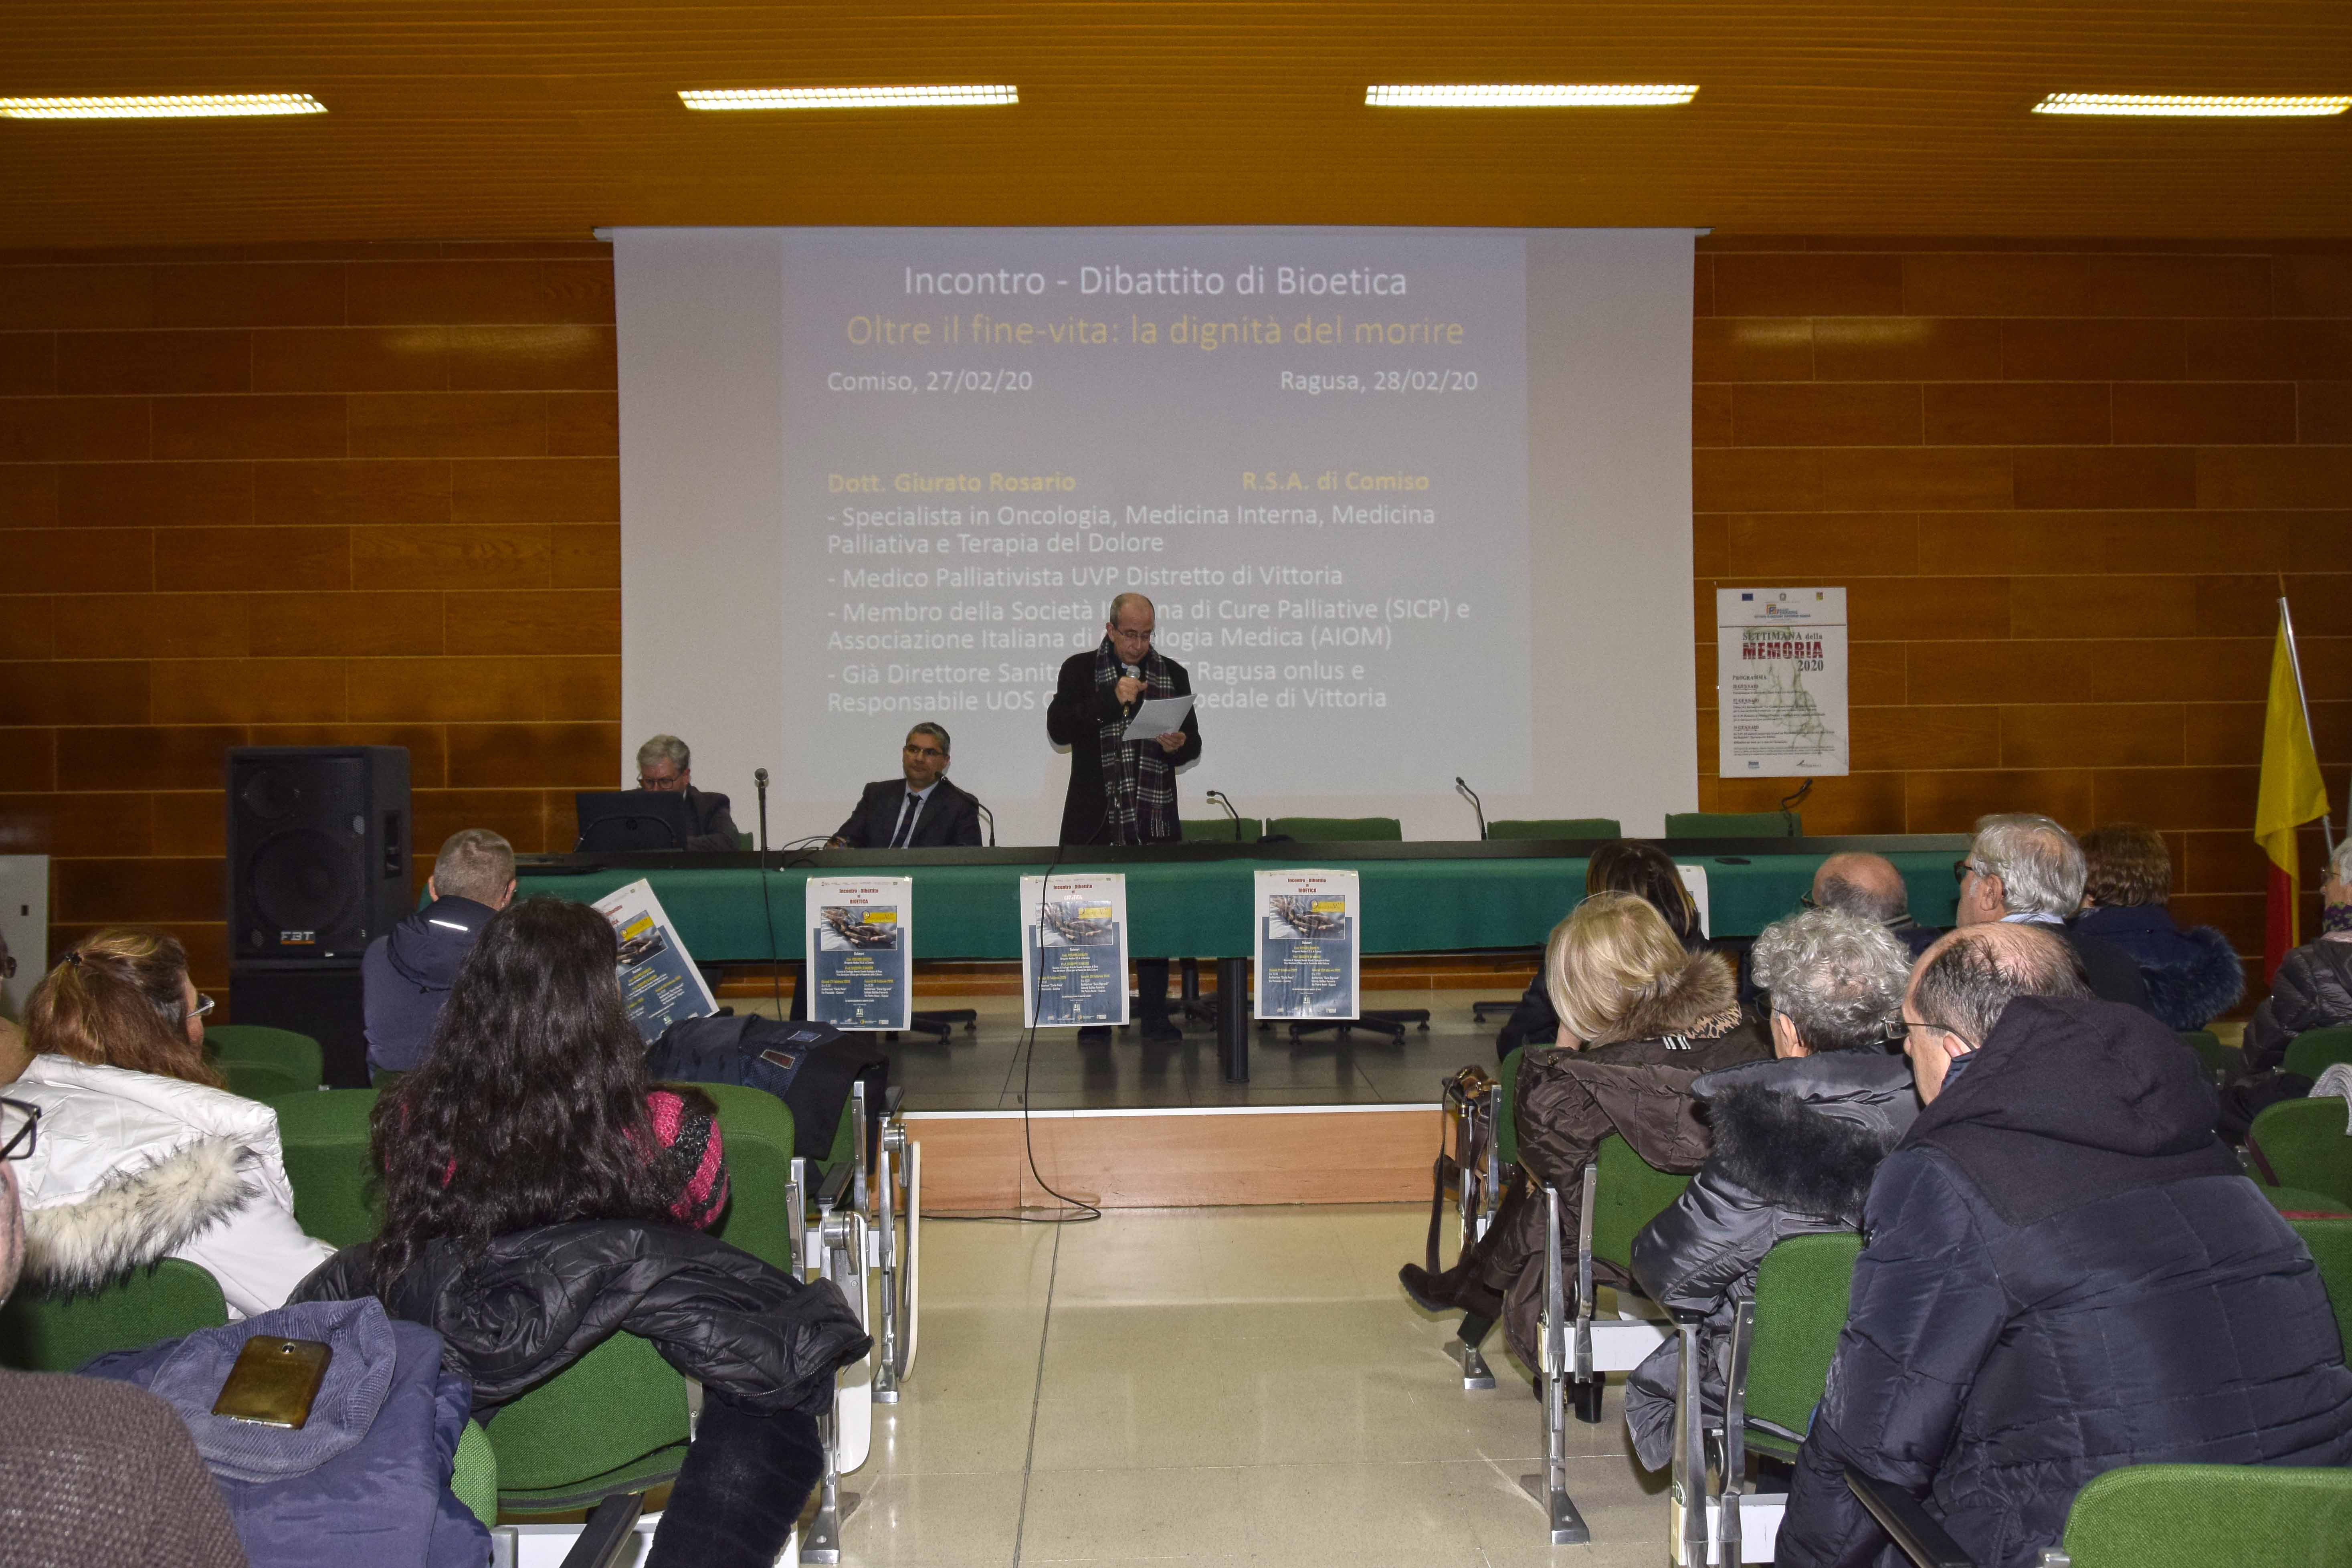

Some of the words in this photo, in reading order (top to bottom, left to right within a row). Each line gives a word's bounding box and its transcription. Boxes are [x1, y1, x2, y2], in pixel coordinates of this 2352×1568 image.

[906, 267, 1045, 295] Incontro
[1080, 265, 1224, 295] Dibattito
[1236, 265, 1265, 295] di
[1277, 266, 1407, 296] Bioetica
[848, 315, 931, 345] Oltre
[942, 315, 961, 344] il
[972, 314, 1119, 345] fine-vita:
[1131, 314, 1158, 344] la
[1170, 314, 1282, 351] dignità
[1294, 315, 1344, 344] del
[1355, 317, 1464, 345] morire
[828, 372, 918, 394] Comiso,
[927, 369, 1033, 394] 27/02/20
[1281, 371, 1366, 395] Ragusa,
[1374, 369, 1479, 394] 28/02/20
[828, 474, 886, 493] Dott.
[895, 473, 982, 493] Giurato
[989, 472, 1076, 493] Rosario
[1243, 471, 1309, 490] R.S.A.
[1318, 471, 1337, 490] di
[1346, 471, 1430, 491] Comiso
[843, 505, 962, 530] Specialista
[970, 506, 989, 525] in
[998, 505, 1117, 530] Oncologia,
[1126, 504, 1229, 525] Medicina
[1237, 505, 1324, 528] Interna,
[1332, 504, 1435, 525] Medicina
[828, 533, 929, 554] Palliativa
[937, 539, 950, 554] e
[956, 533, 1039, 558] Terapia
[1047, 531, 1081, 553] del
[1089, 531, 1164, 553] Dolore
[844, 568, 929, 588] Medico
[937, 566, 1063, 588] Palliativista
[1071, 567, 1119, 587] UVP
[1127, 566, 1225, 586] Distretto
[1232, 565, 1252, 586] di
[1259, 565, 1343, 585] Vittoria
[844, 601, 942, 623] Membro
[950, 600, 1004, 622] della
[1012, 599, 1093, 621] Società
[1191, 599, 1211, 620] di
[1218, 600, 1270, 620] Cure
[1278, 598, 1378, 619] Palliative
[1386, 597, 1449, 624] (SICP)
[1457, 604, 1470, 619] e
[828, 629, 974, 650] Associazione
[982, 628, 1065, 649] Italiana
[1072, 626, 1093, 648] di
[1221, 626, 1303, 647] Medica
[1312, 626, 1391, 651] (AIOM)
[1742, 632, 1802, 641] SETTIMANA
[1742, 641, 1824, 660] MEMORIA
[845, 663, 879, 685] Già
[888, 664, 991, 685] Direttore
[1197, 661, 1277, 686] Ragusa
[1284, 660, 1344, 681] onlus
[1352, 665, 1364, 680] e
[1798, 660, 1824, 672] 2020
[828, 691, 978, 717] Responsabile
[986, 690, 1035, 711] UOS
[1277, 687, 1296, 708] di
[1302, 687, 1387, 708] Vittoria
[281, 931, 314, 941] FBT
